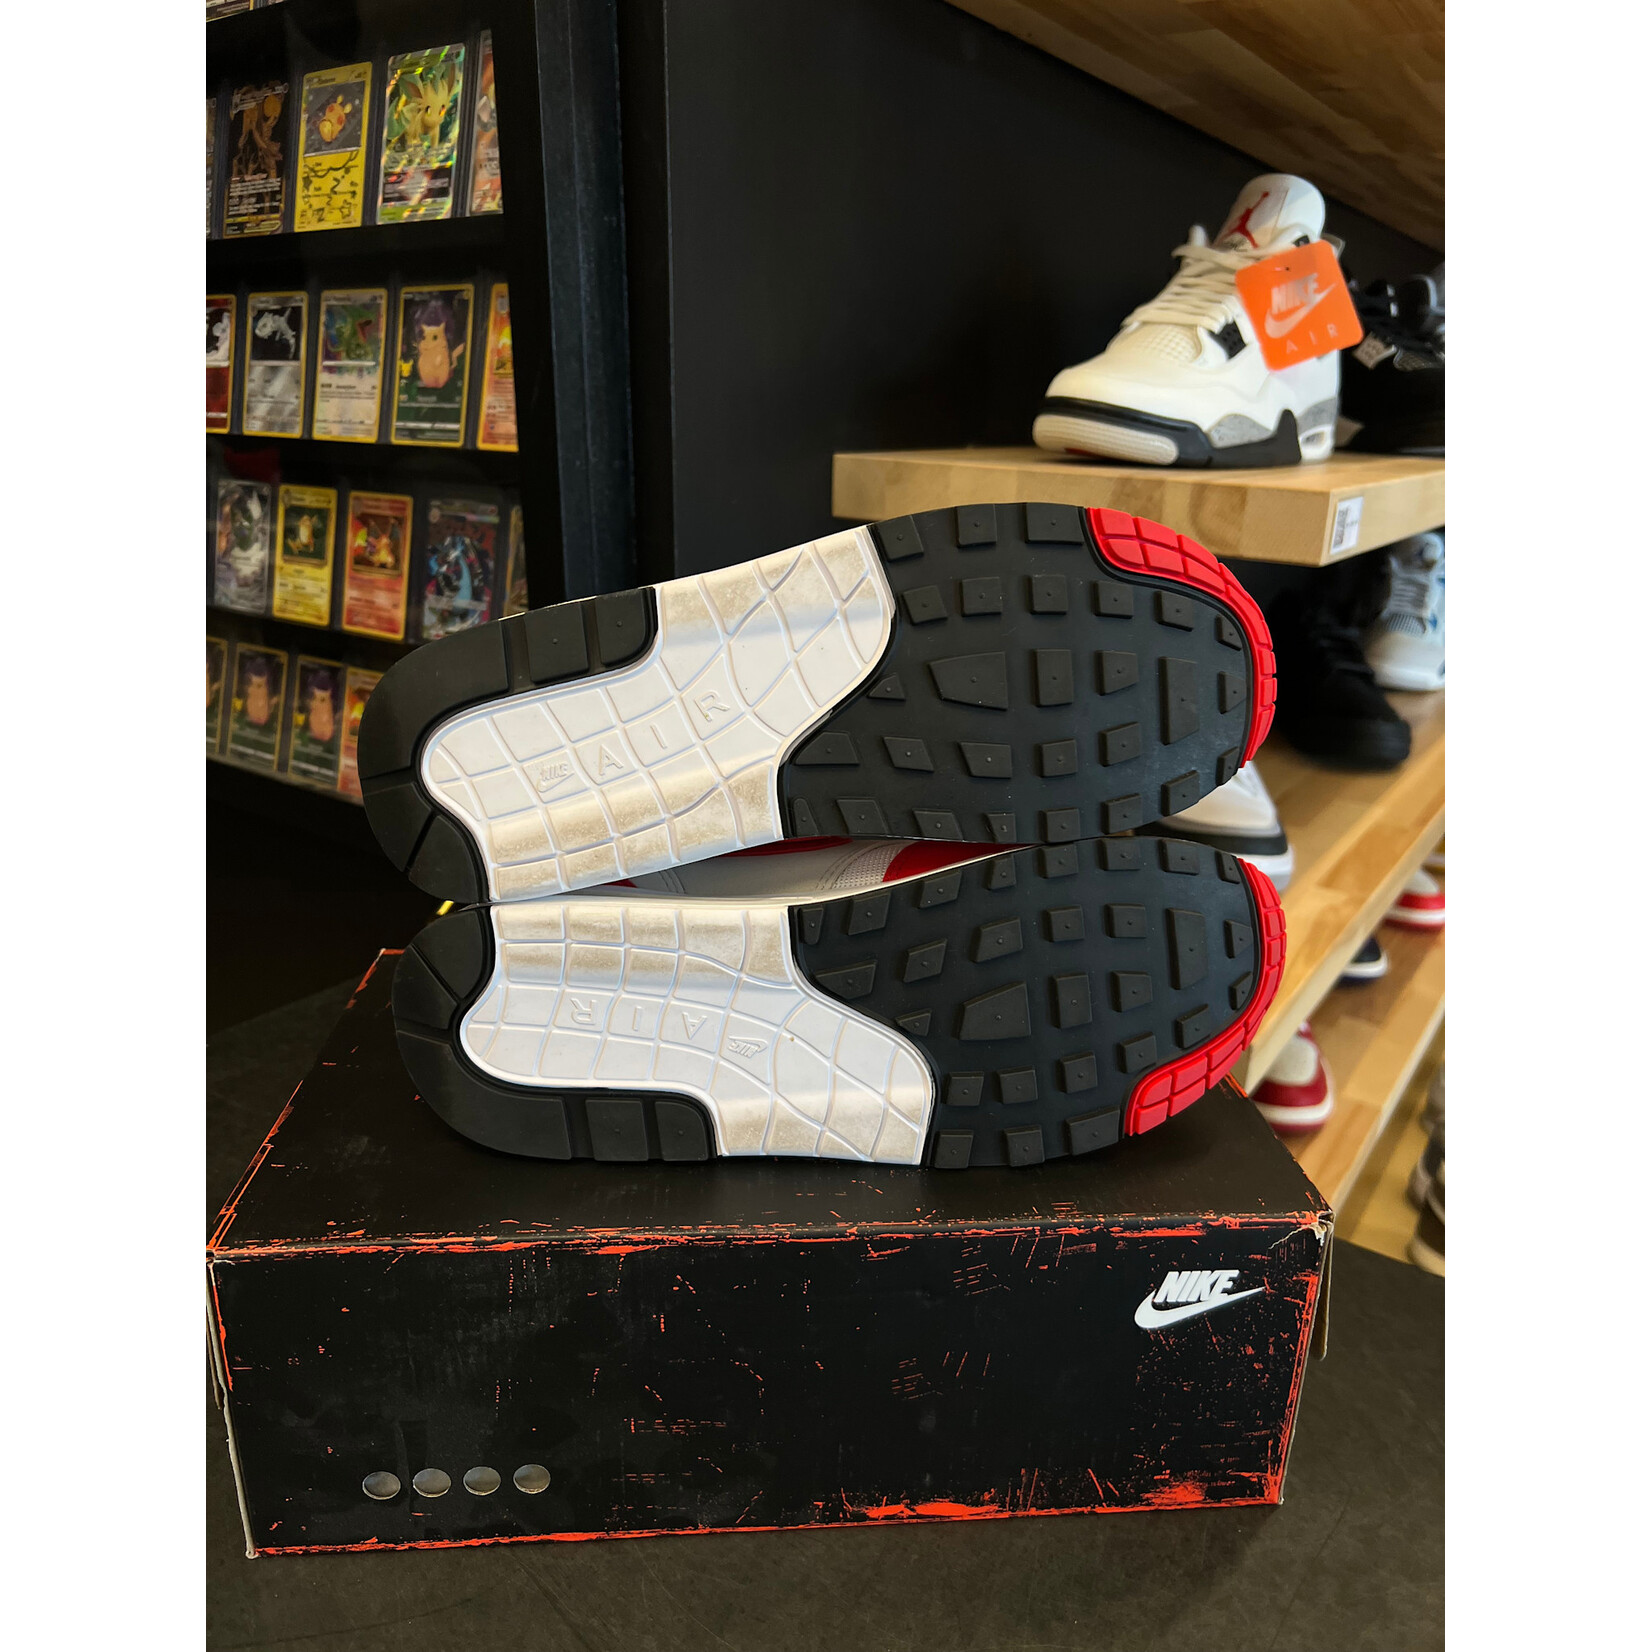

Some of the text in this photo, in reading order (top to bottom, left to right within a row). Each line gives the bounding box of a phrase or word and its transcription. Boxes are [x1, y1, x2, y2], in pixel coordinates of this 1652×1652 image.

[1271, 272, 1318, 315] NIKE
[1286, 323, 1338, 355] AIR
[539, 690, 731, 781] NIKE AIR
[569, 997, 756, 1059] NIKE AIR
[1154, 1269, 1240, 1303] NIKE
